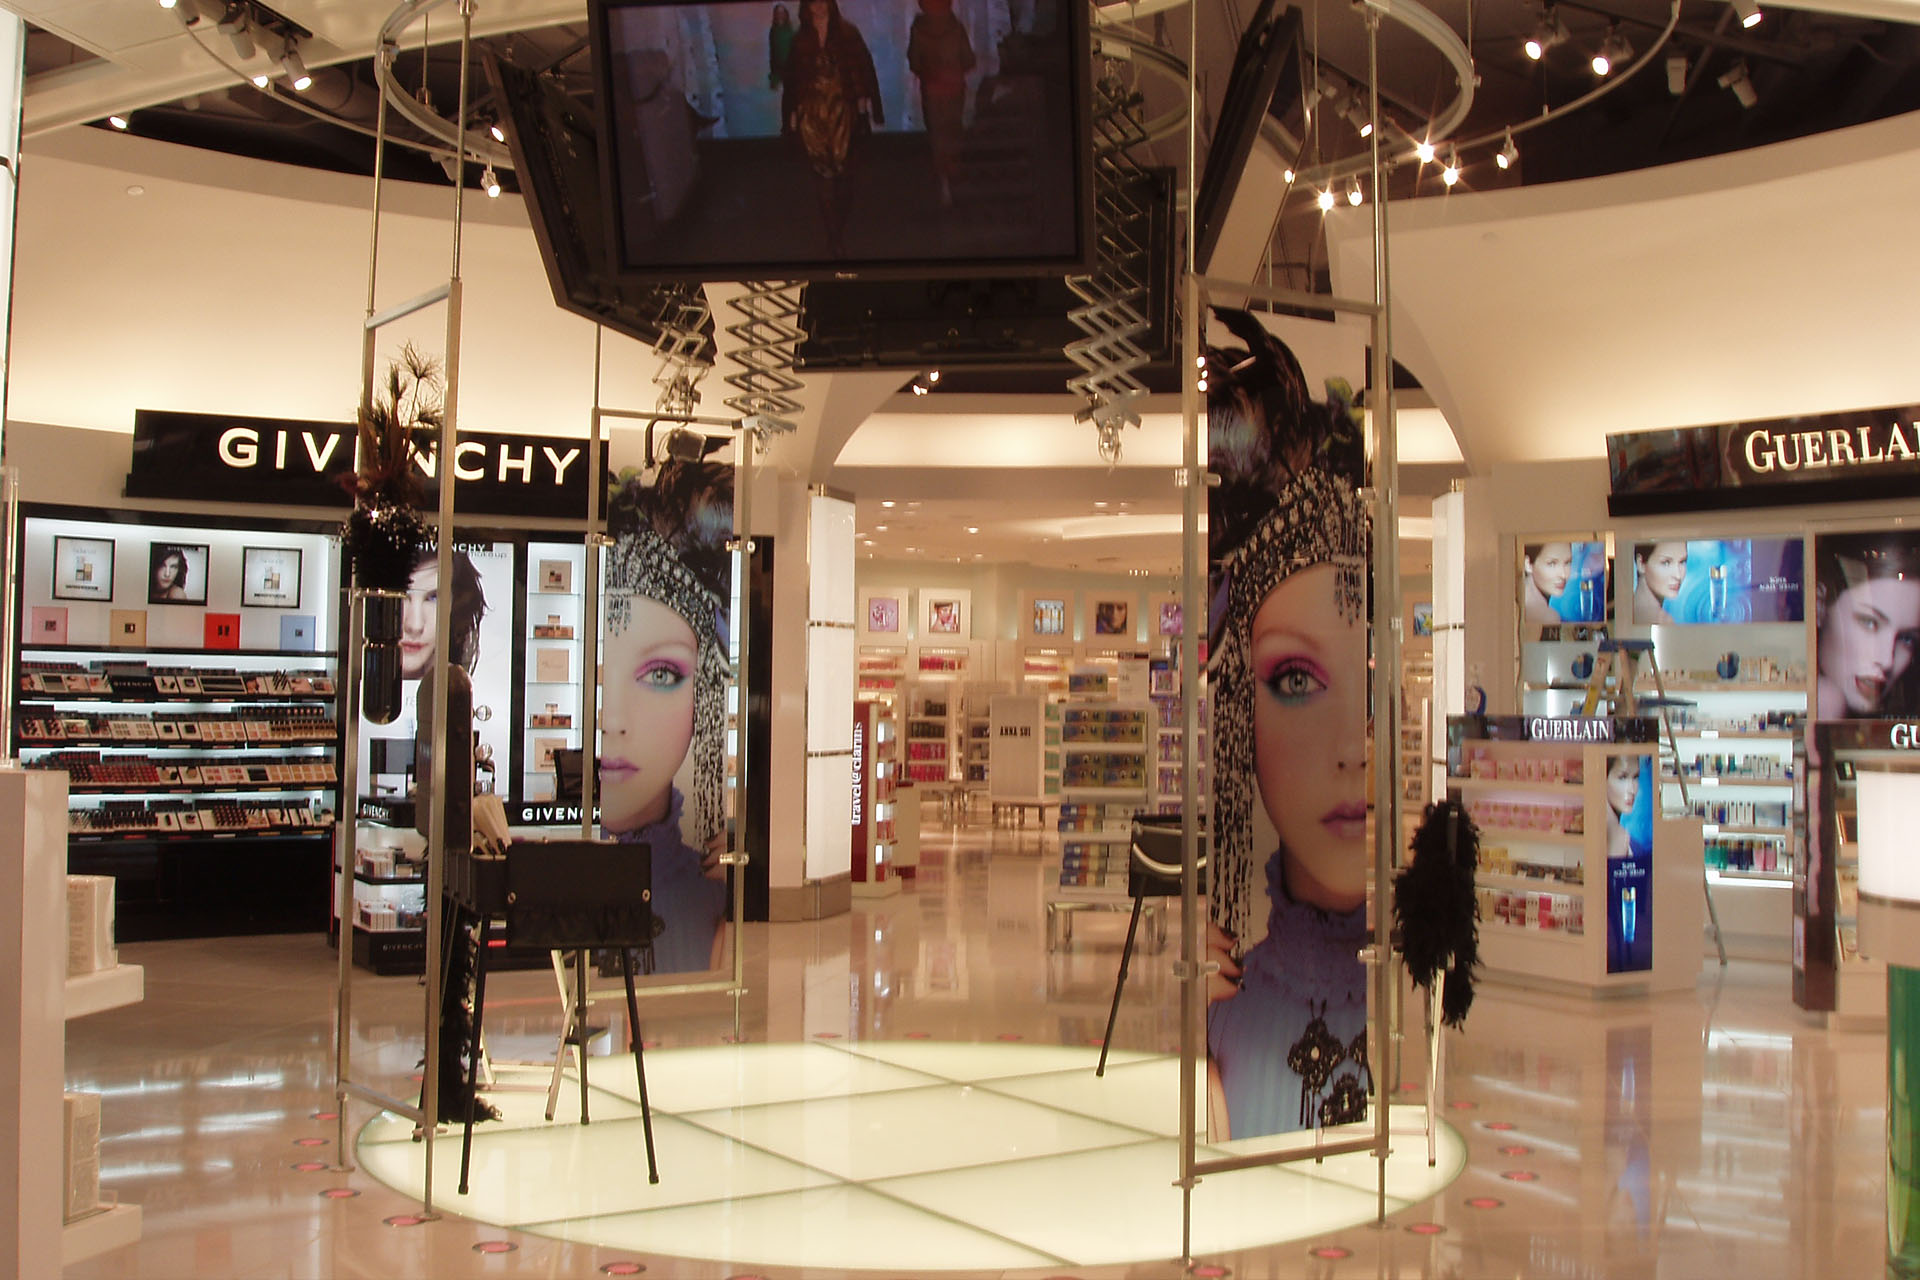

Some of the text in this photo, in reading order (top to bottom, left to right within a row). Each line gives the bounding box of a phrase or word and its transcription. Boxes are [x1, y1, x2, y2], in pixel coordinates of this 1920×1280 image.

[218, 427, 580, 486] GIVNCHY
[1000, 726, 1031, 737] ANNA SUI
[1531, 717, 1610, 740] GUERLAIN
[363, 803, 390, 820] GIVENCHY
